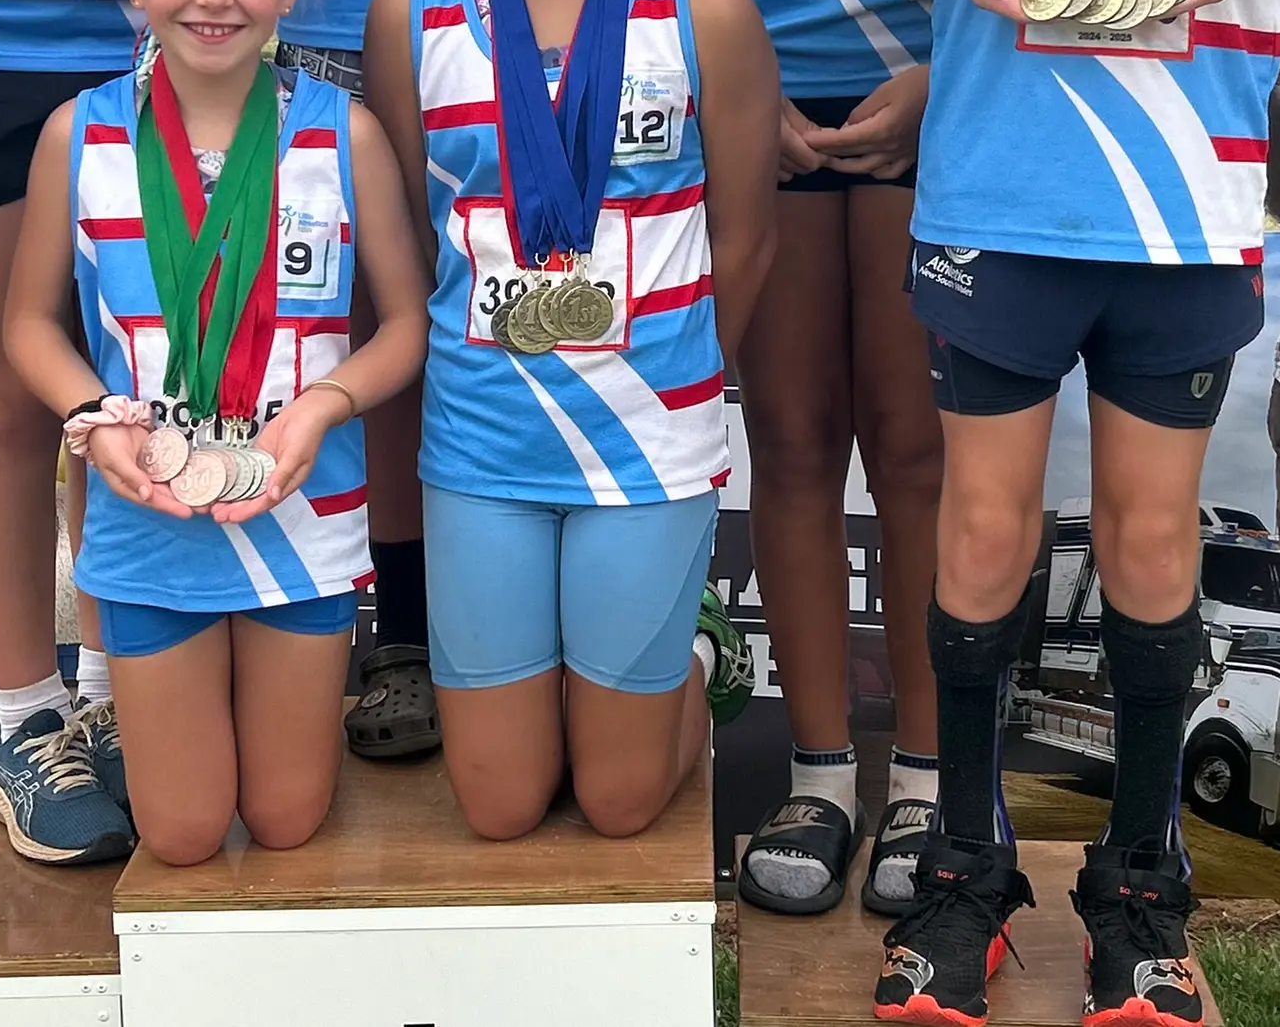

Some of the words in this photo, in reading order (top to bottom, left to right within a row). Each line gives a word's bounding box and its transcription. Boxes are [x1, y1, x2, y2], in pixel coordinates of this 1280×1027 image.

[1078, 32, 1101, 41] 2024
[1109, 32, 1132, 42] 2025
[620, 110, 665, 144] 12
[284, 241, 312, 276] 9
[926, 256, 974, 286] Athletics
[773, 805, 824, 824] NIKE
[891, 806, 935, 826] NIK
